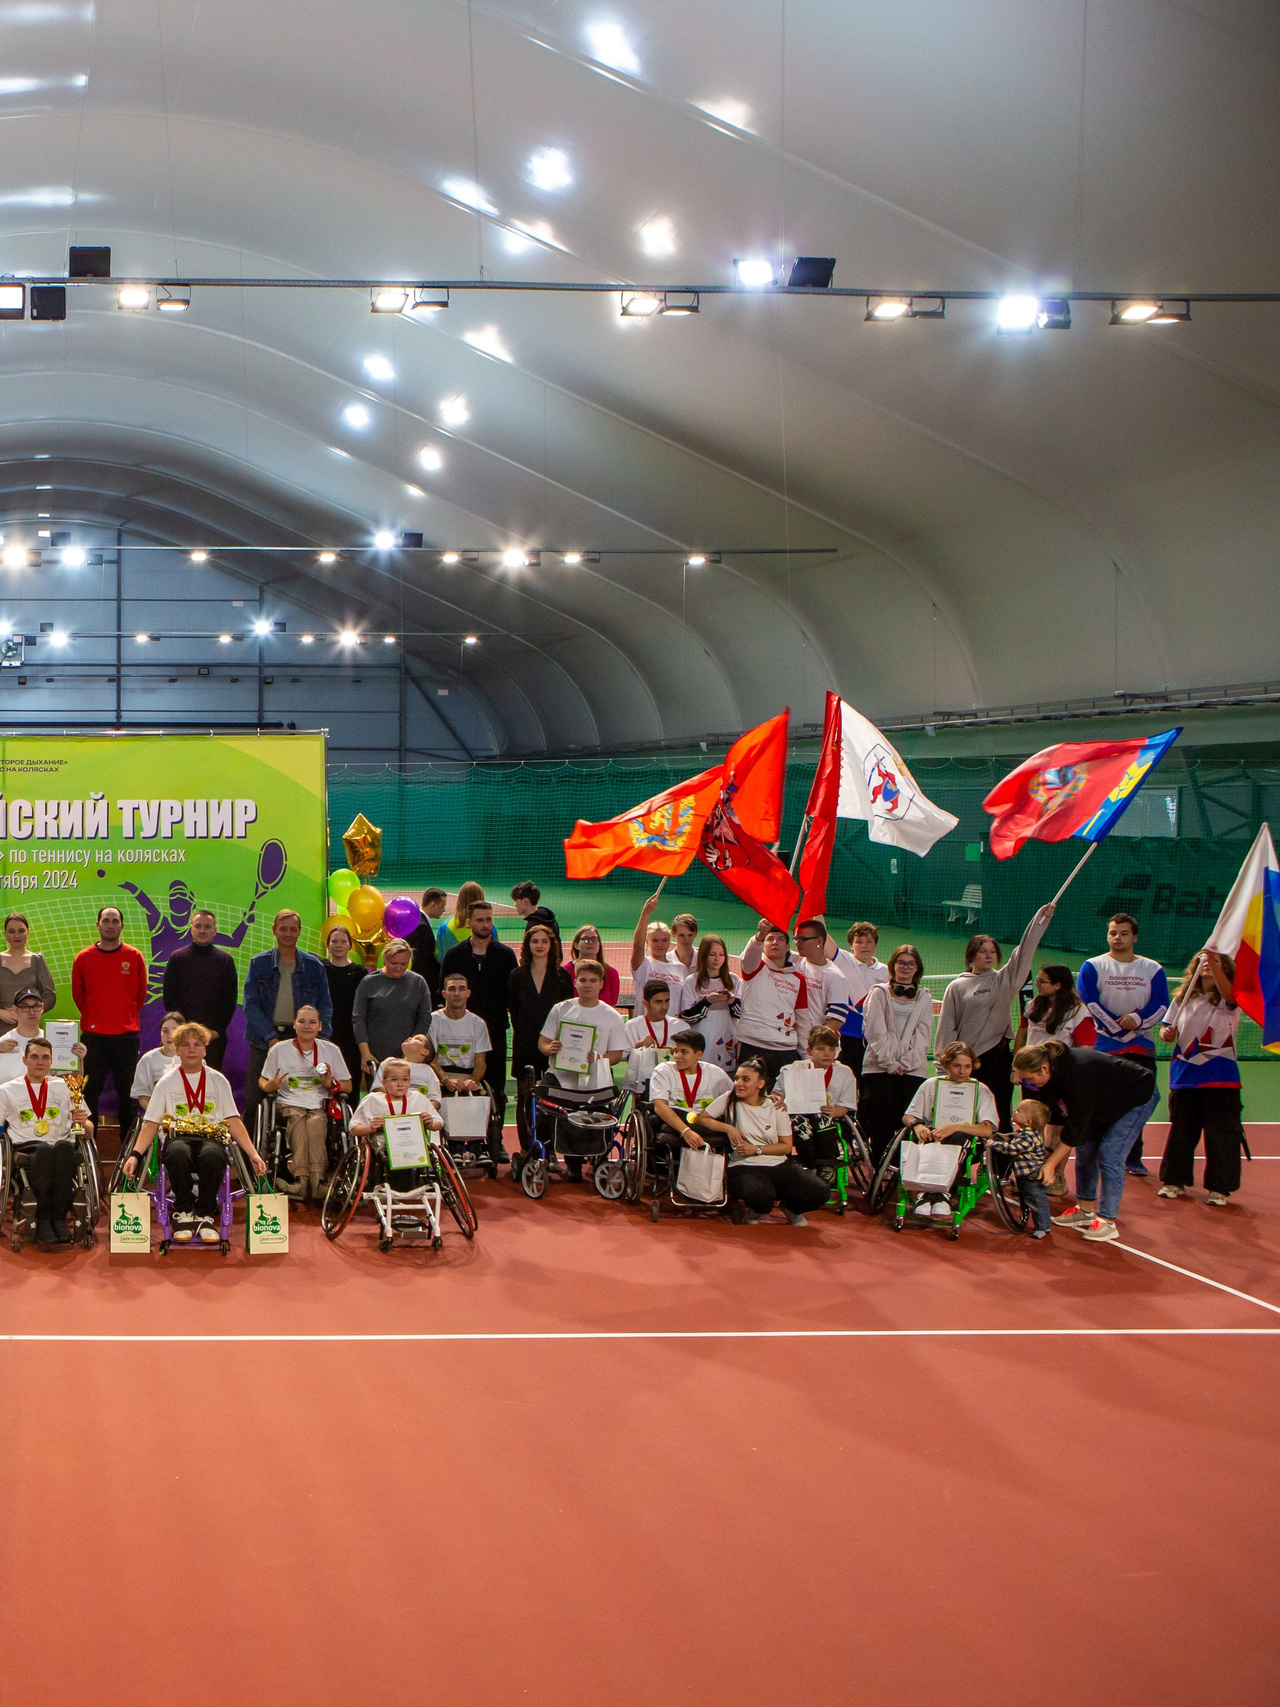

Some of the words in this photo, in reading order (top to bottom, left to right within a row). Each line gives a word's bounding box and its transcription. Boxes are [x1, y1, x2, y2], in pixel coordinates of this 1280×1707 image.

[117, 798, 257, 840] ТУРНИР
[9, 849, 27, 864] по
[31, 849, 91, 868] теннису
[95, 849, 112, 864] на
[117, 849, 186, 864] колясках
[43, 870, 79, 890] 2024
[114, 1223, 142, 1231] bionova
[253, 1223, 281, 1231] bionova
